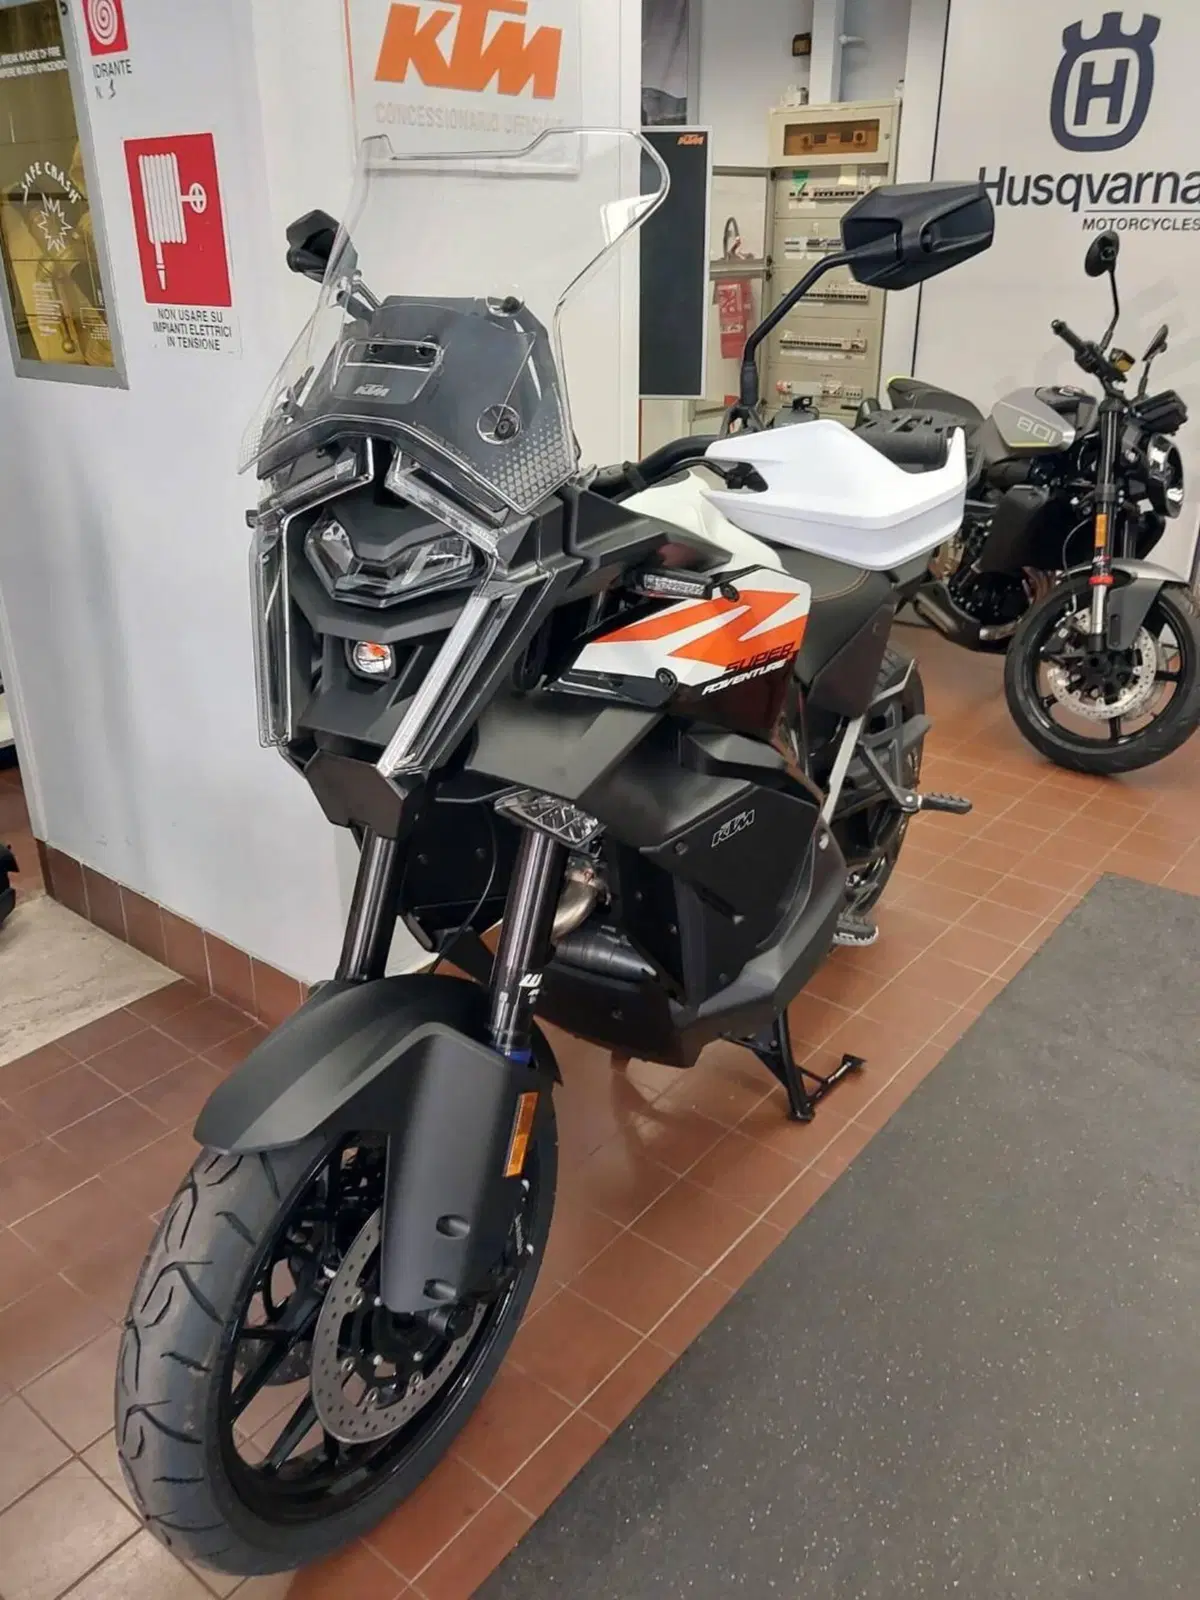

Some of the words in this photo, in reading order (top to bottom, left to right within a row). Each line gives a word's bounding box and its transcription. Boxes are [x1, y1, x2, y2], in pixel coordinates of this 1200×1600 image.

[374, 0, 563, 101] KTM
[92, 59, 133, 80] IDRANTE
[977, 165, 1200, 213] Husqvarna
[1081, 216, 1200, 232] MOTORCYCLES
[157, 308, 177, 320] NON
[178, 309, 209, 322] USARE
[210, 311, 223, 323] SU
[189, 323, 233, 338] ELETTRICI
[177, 336, 220, 350] TENSIONE
[353, 383, 390, 397] KTM
[1017, 416, 1057, 443] 801
[724, 641, 796, 672] SUPER
[701, 658, 789, 696] ADVENTURE
[711, 809, 755, 848] KTM
